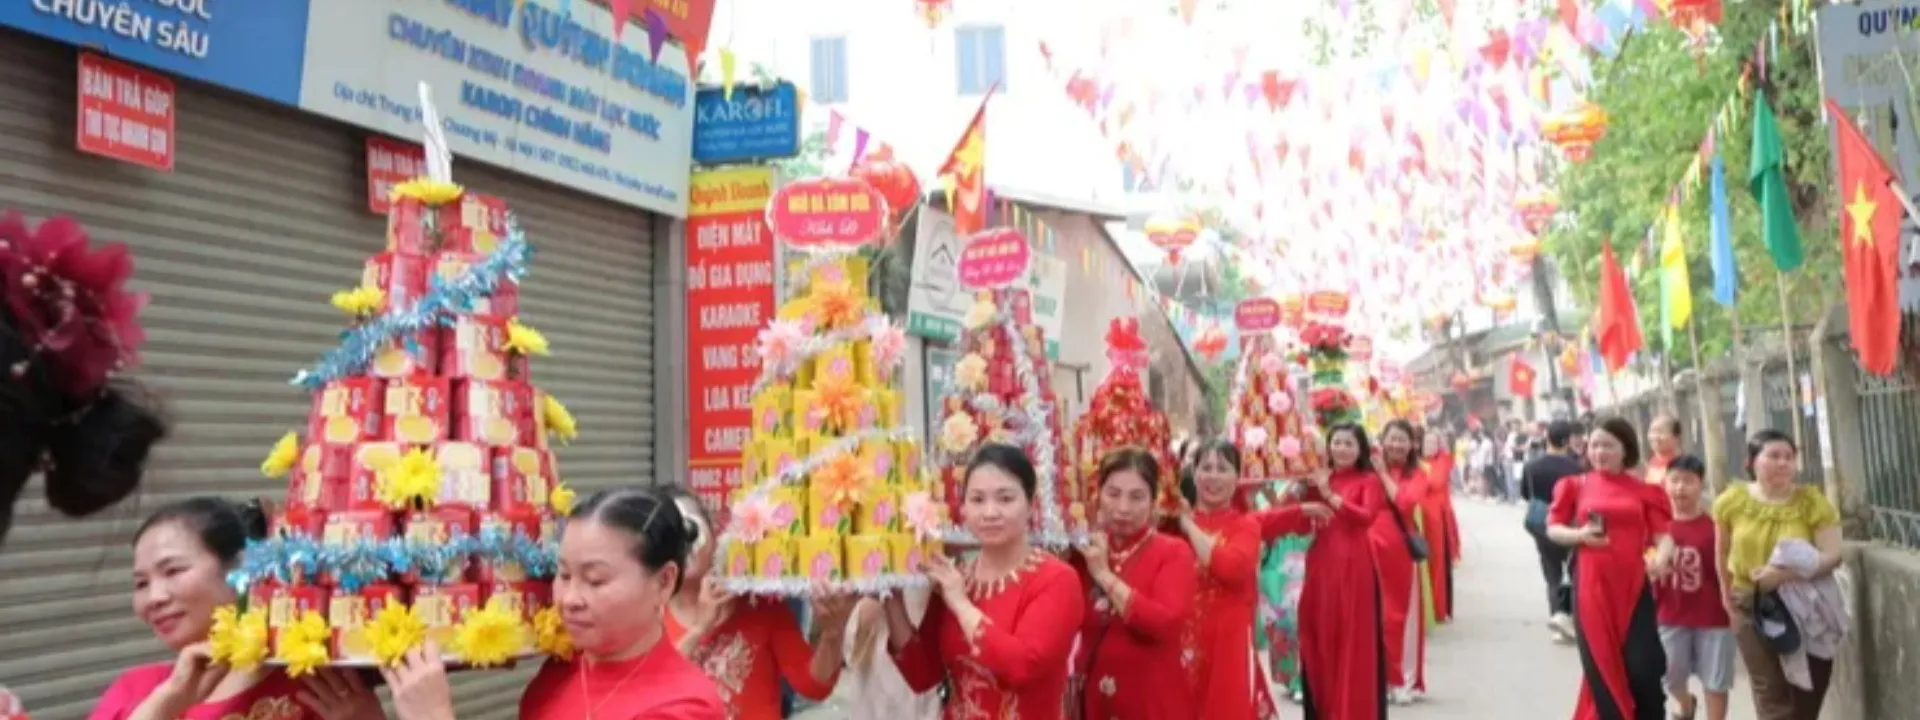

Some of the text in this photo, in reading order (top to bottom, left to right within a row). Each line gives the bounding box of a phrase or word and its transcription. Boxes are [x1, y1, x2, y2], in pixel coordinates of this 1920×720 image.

[156, 20, 209, 59] SÂU
[709, 262, 733, 288] GIA
[701, 302, 761, 329] KARAOKE
[703, 344, 738, 370] VANG
[704, 385, 731, 412] LOA
